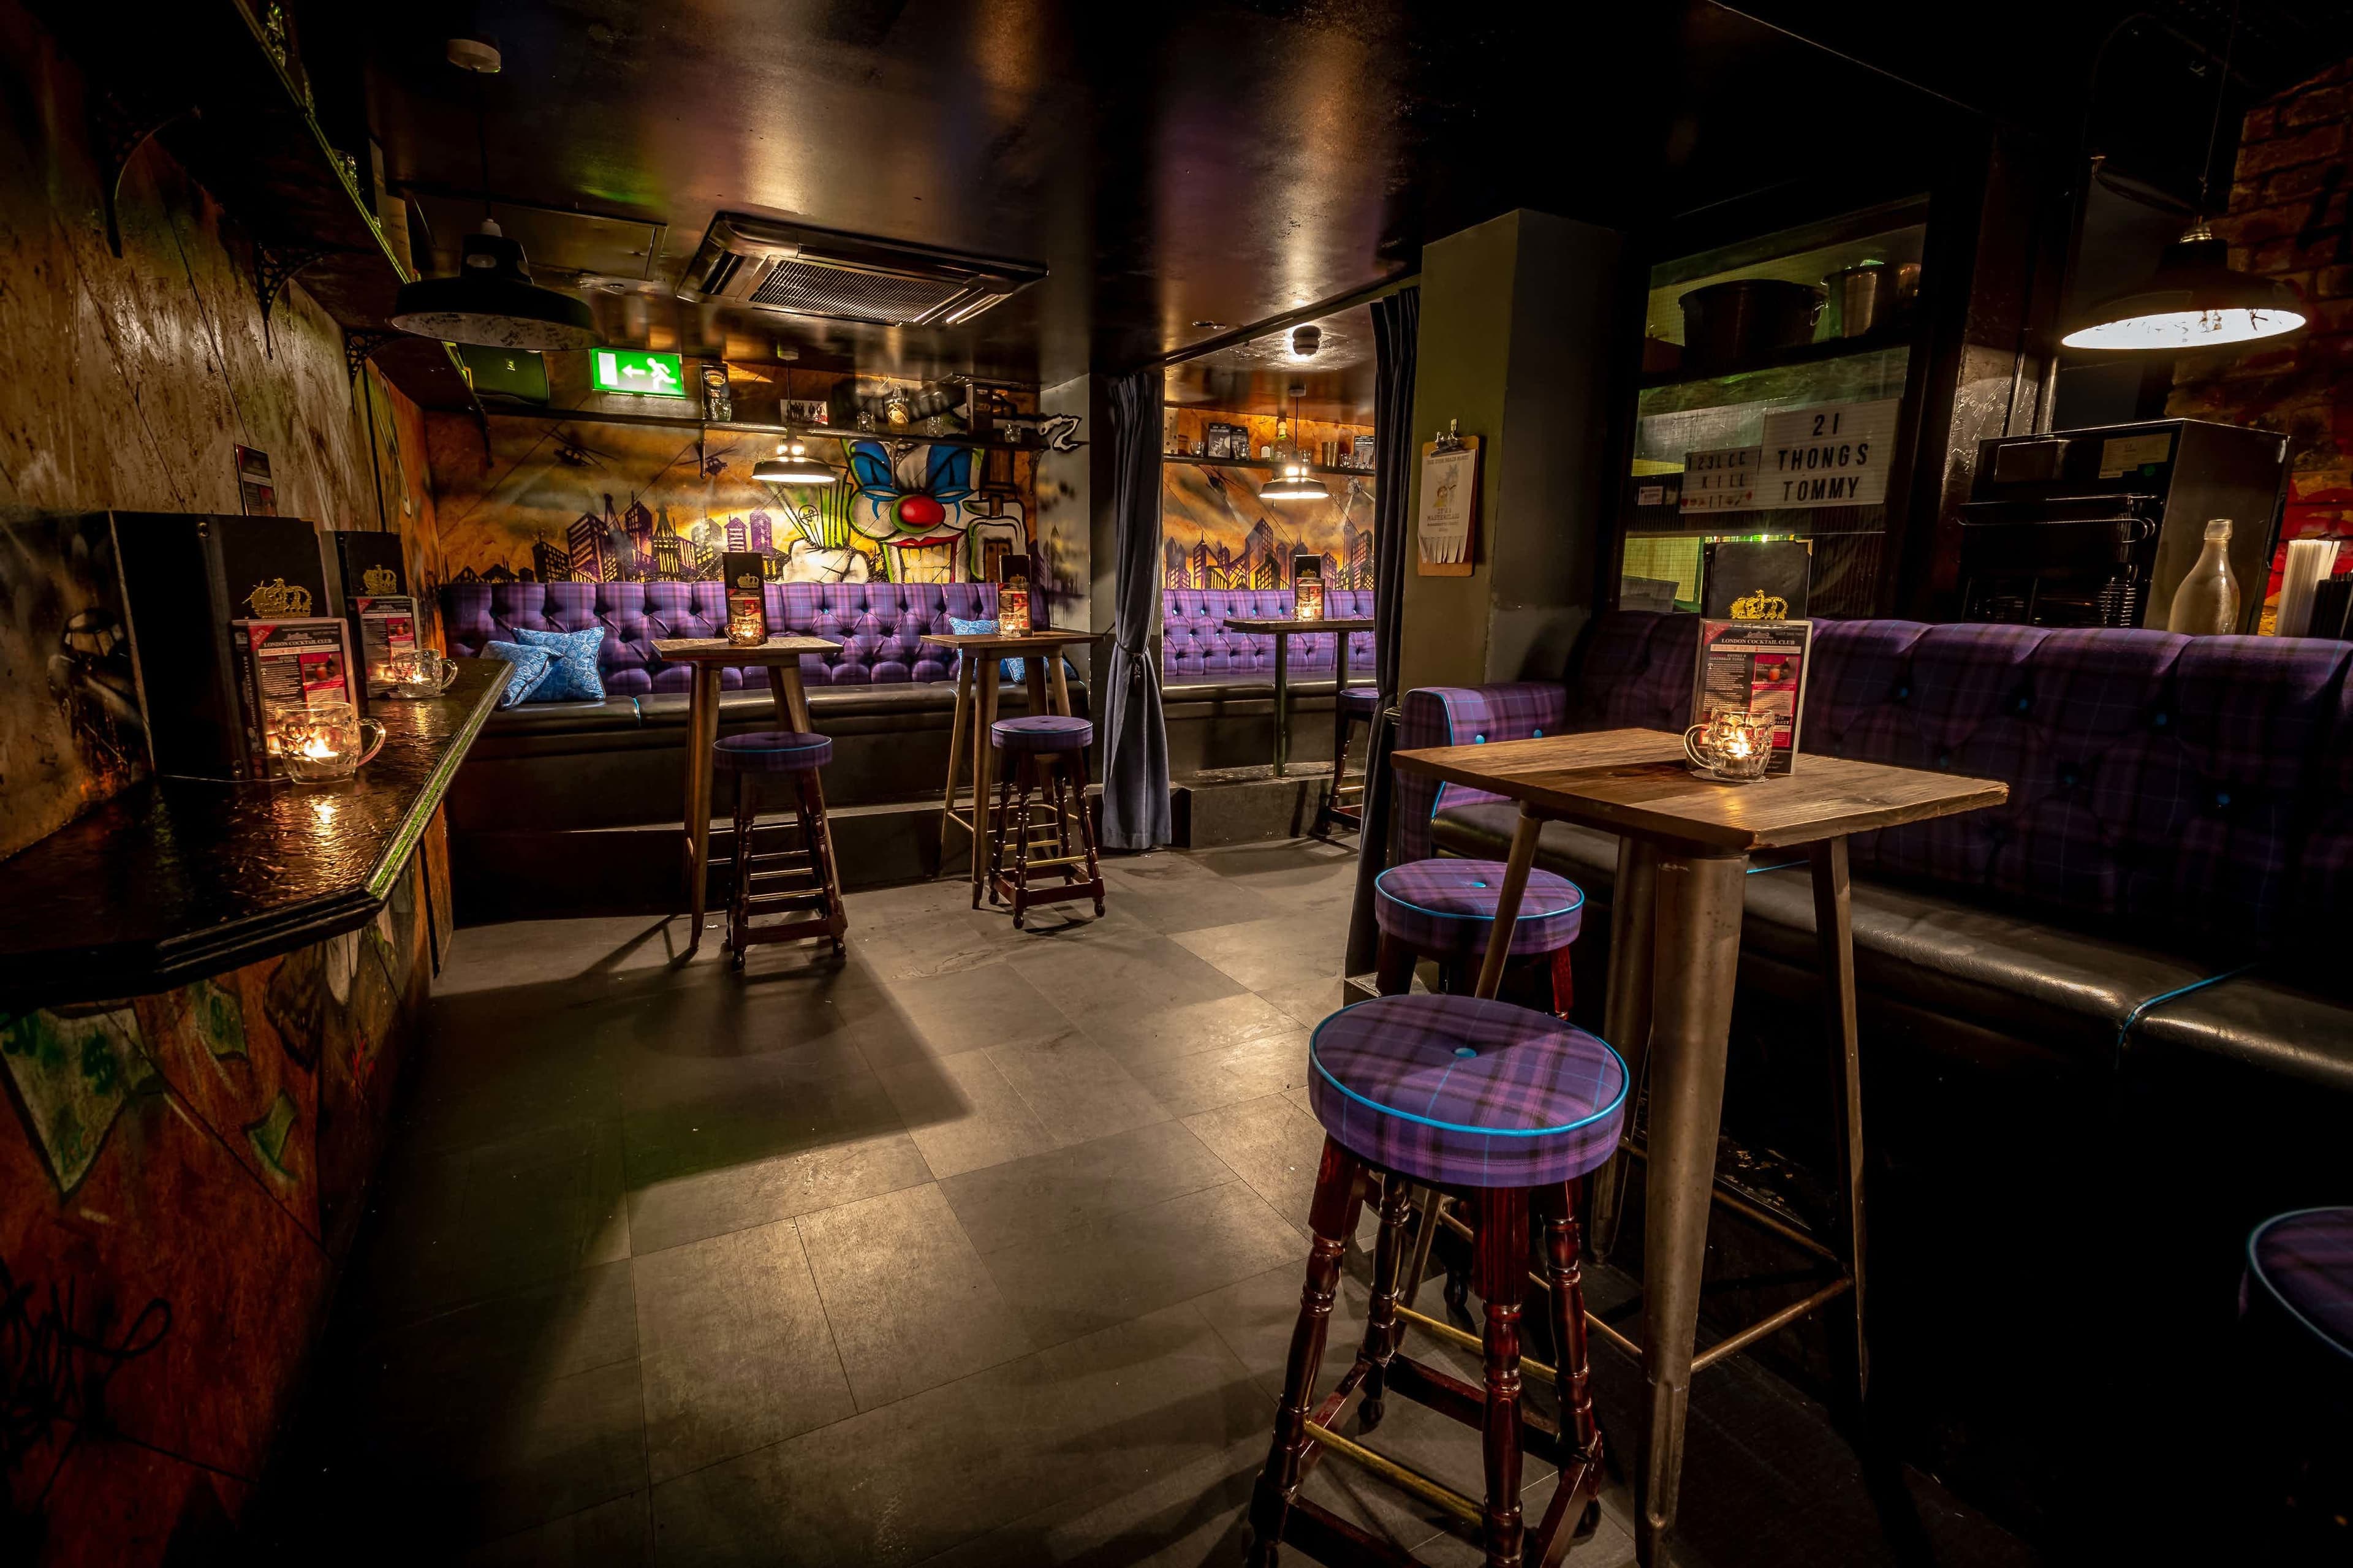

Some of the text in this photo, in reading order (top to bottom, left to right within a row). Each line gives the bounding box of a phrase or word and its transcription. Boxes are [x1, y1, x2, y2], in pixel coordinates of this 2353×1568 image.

[1812, 412, 1840, 436] 21
[1778, 443, 1869, 471] THONGS
[1783, 476, 1860, 501] TOMMY
